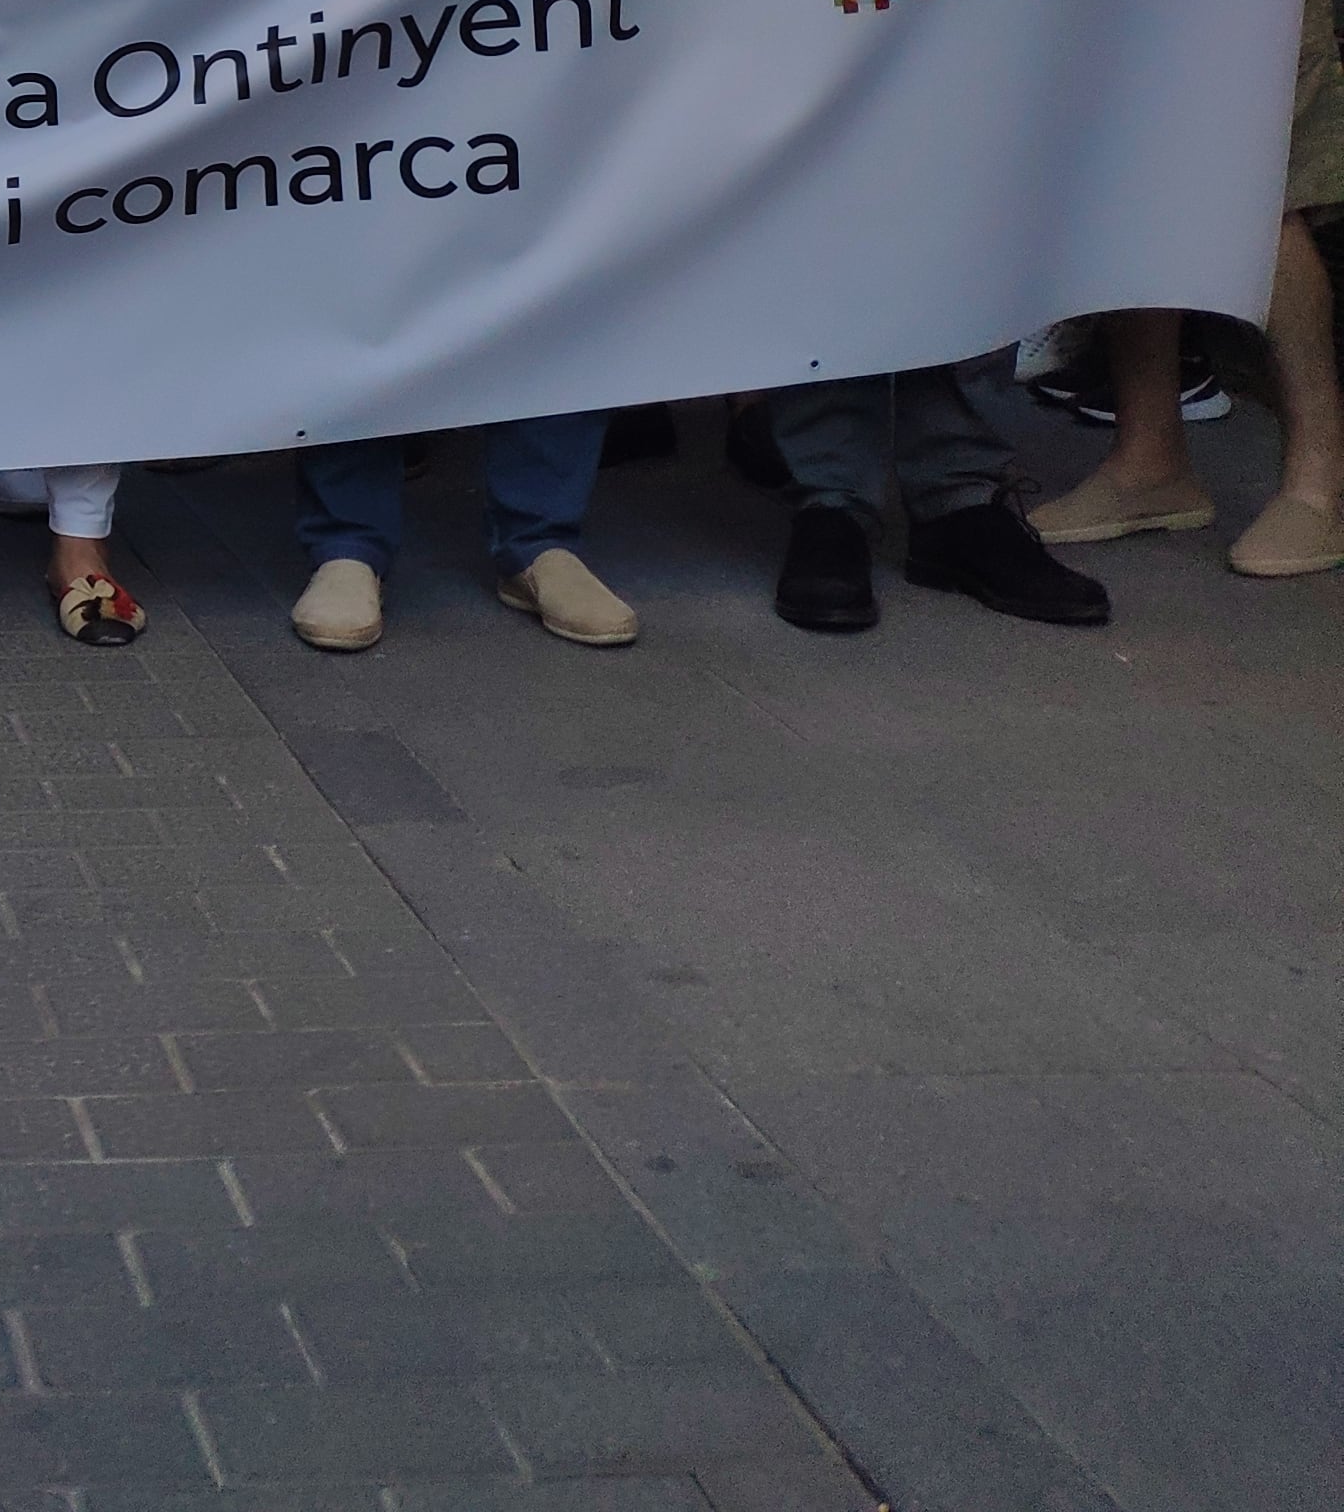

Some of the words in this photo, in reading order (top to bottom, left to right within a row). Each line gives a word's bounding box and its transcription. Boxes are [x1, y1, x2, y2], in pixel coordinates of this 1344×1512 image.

[5, 71, 60, 129] a
[5, 175, 23, 246] i
[54, 132, 522, 236] comarca
